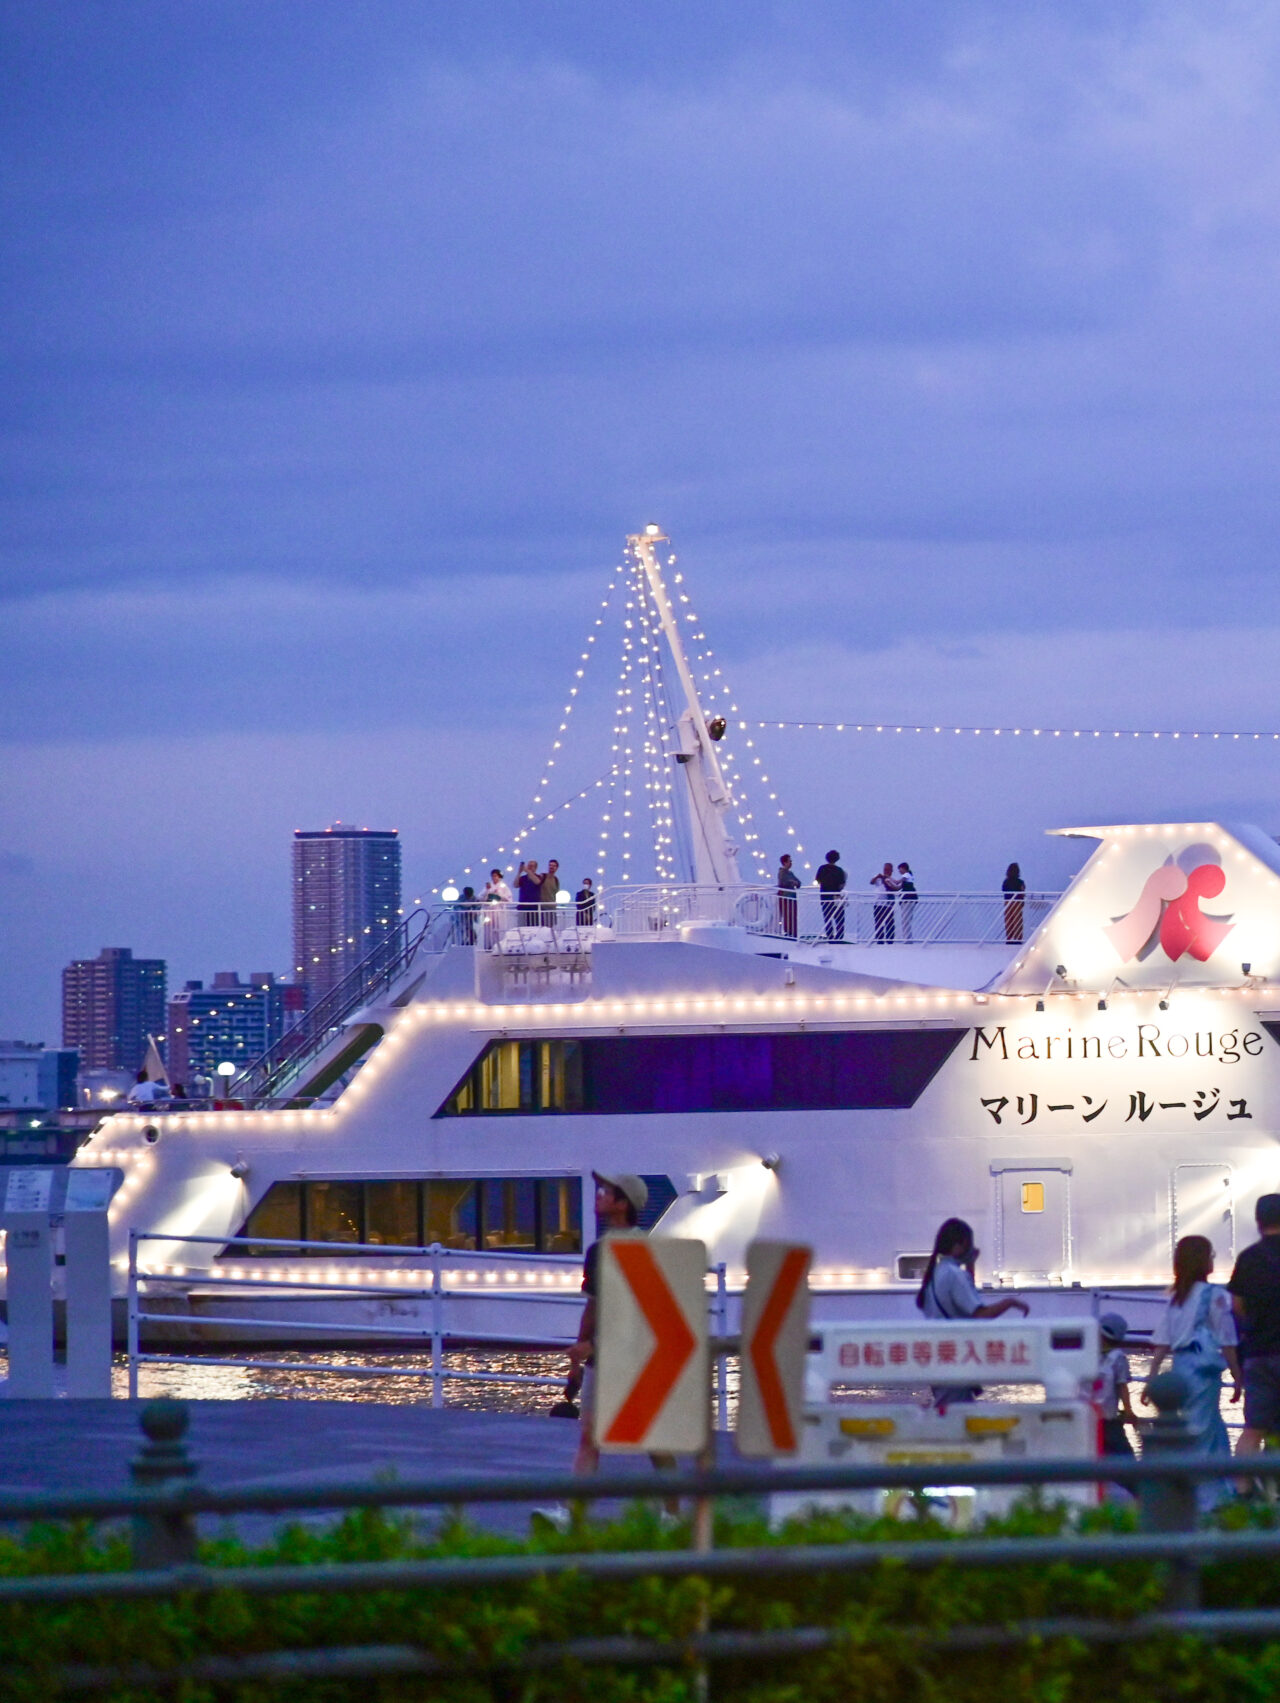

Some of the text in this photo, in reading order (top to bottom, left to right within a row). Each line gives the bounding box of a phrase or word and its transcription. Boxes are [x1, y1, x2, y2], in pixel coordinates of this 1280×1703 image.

[980, 1088, 1253, 1125] マリーン ルージュ
